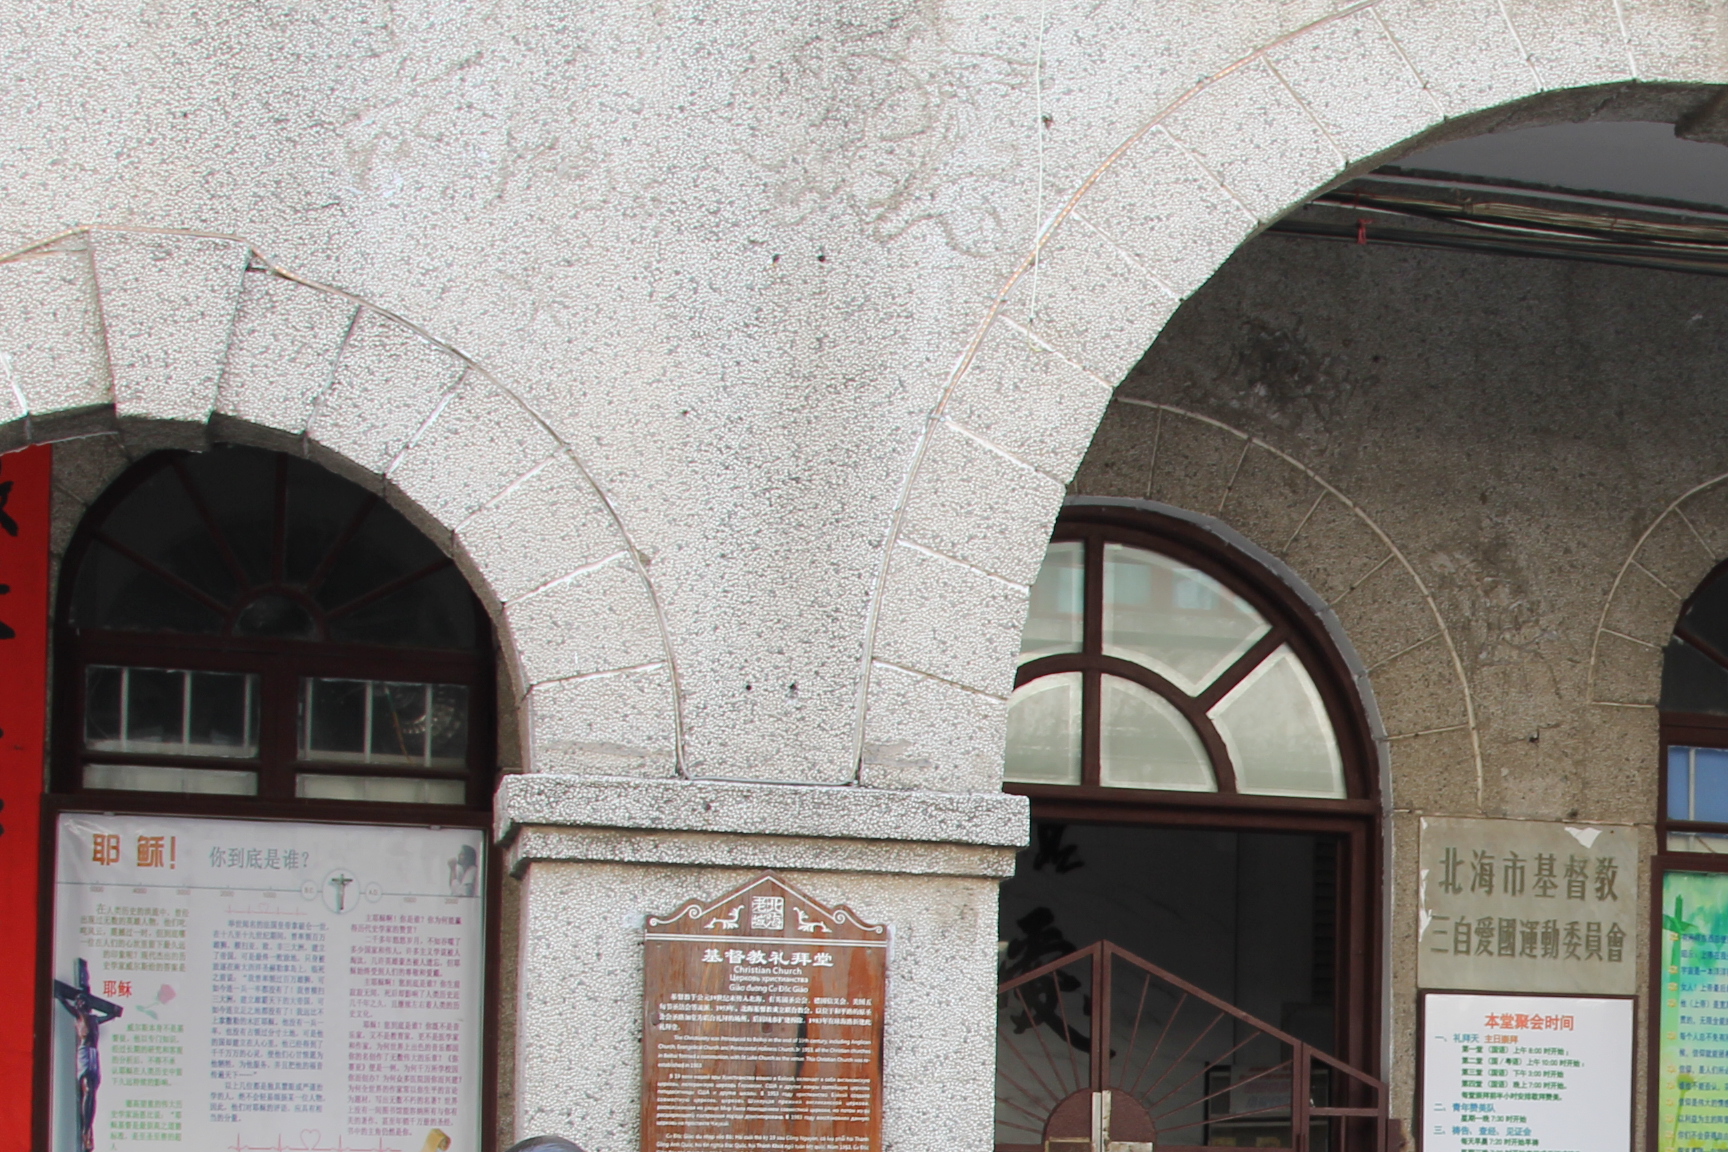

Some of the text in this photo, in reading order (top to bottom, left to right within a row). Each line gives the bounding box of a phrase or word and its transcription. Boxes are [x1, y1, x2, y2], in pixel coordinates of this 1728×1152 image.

[208, 846, 310, 870] 你到底是谁？
[1430, 914, 1627, 963] 三自愛國運動委員會
[701, 948, 834, 968] 基督教礼拜堂
[733, 965, 803, 976] Christian Church
[103, 980, 132, 998] 耶稣
[1484, 1012, 1574, 1031] 本堂聚会时间
